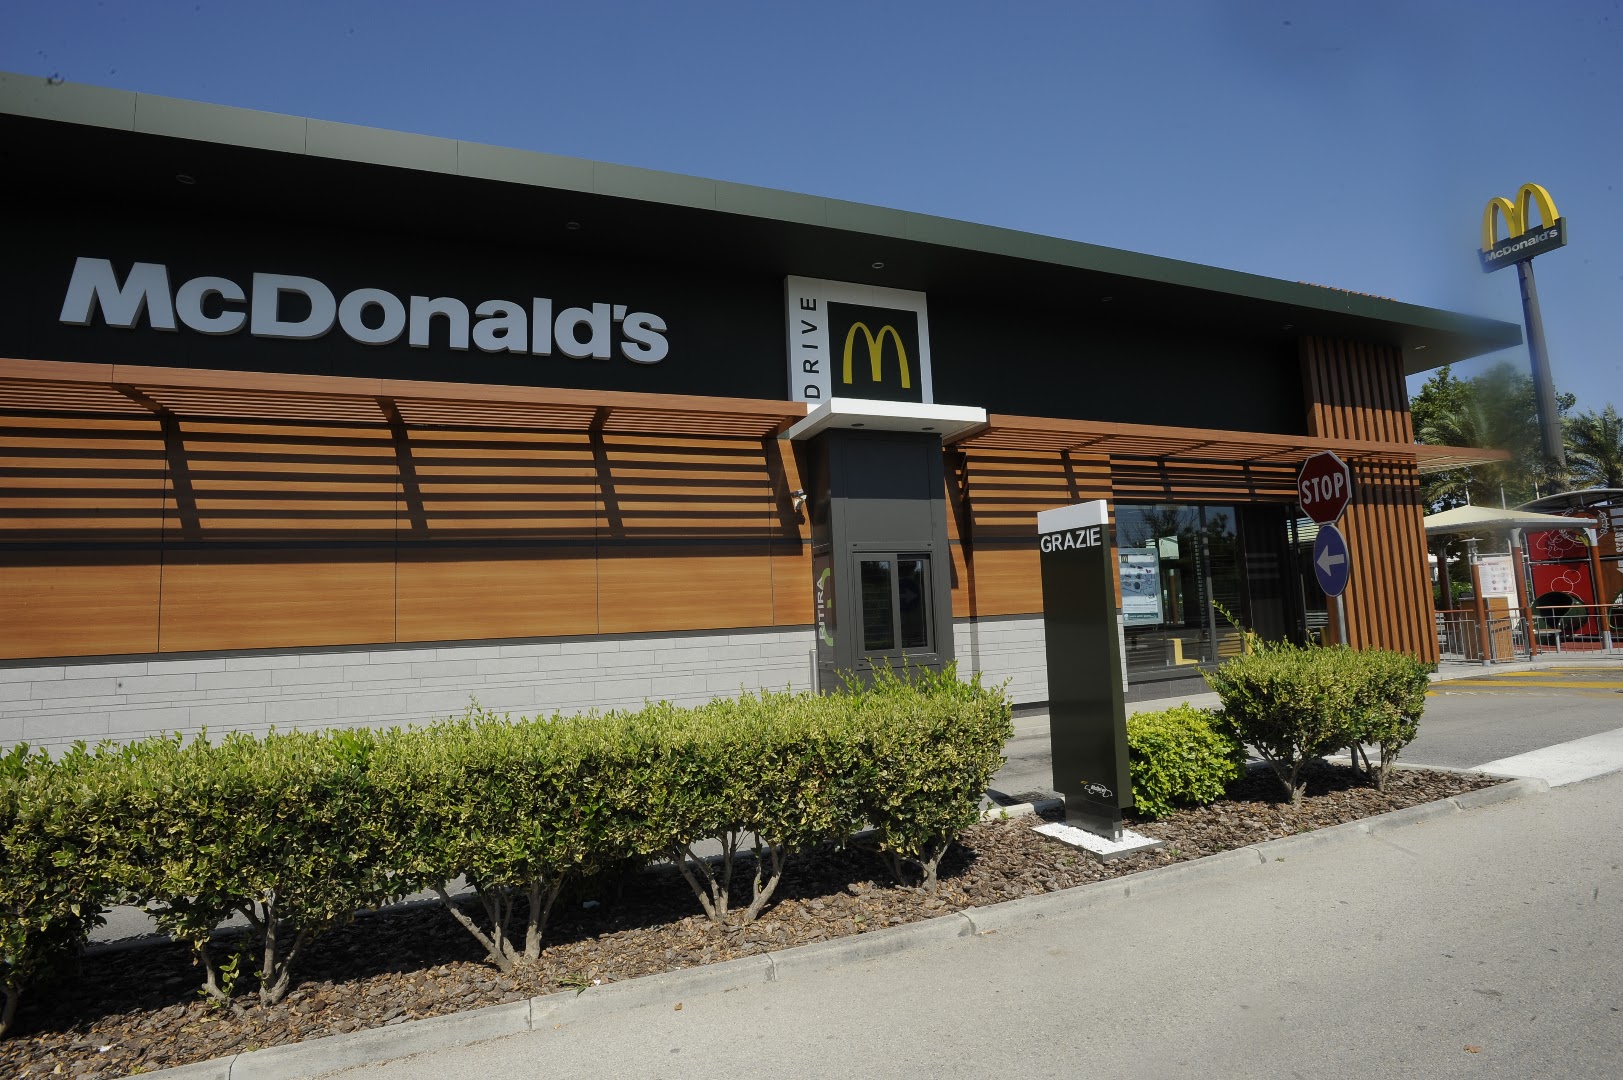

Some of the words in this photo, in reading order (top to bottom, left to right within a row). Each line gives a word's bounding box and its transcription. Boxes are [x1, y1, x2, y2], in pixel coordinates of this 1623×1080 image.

[1485, 229, 1558, 261] McDonald's
[59, 256, 669, 364] McDonald's
[800, 298, 821, 399] DRIVE
[1302, 472, 1343, 505] STOP
[1041, 527, 1102, 553] GRAZIE
[817, 576, 826, 640] RITIRA
